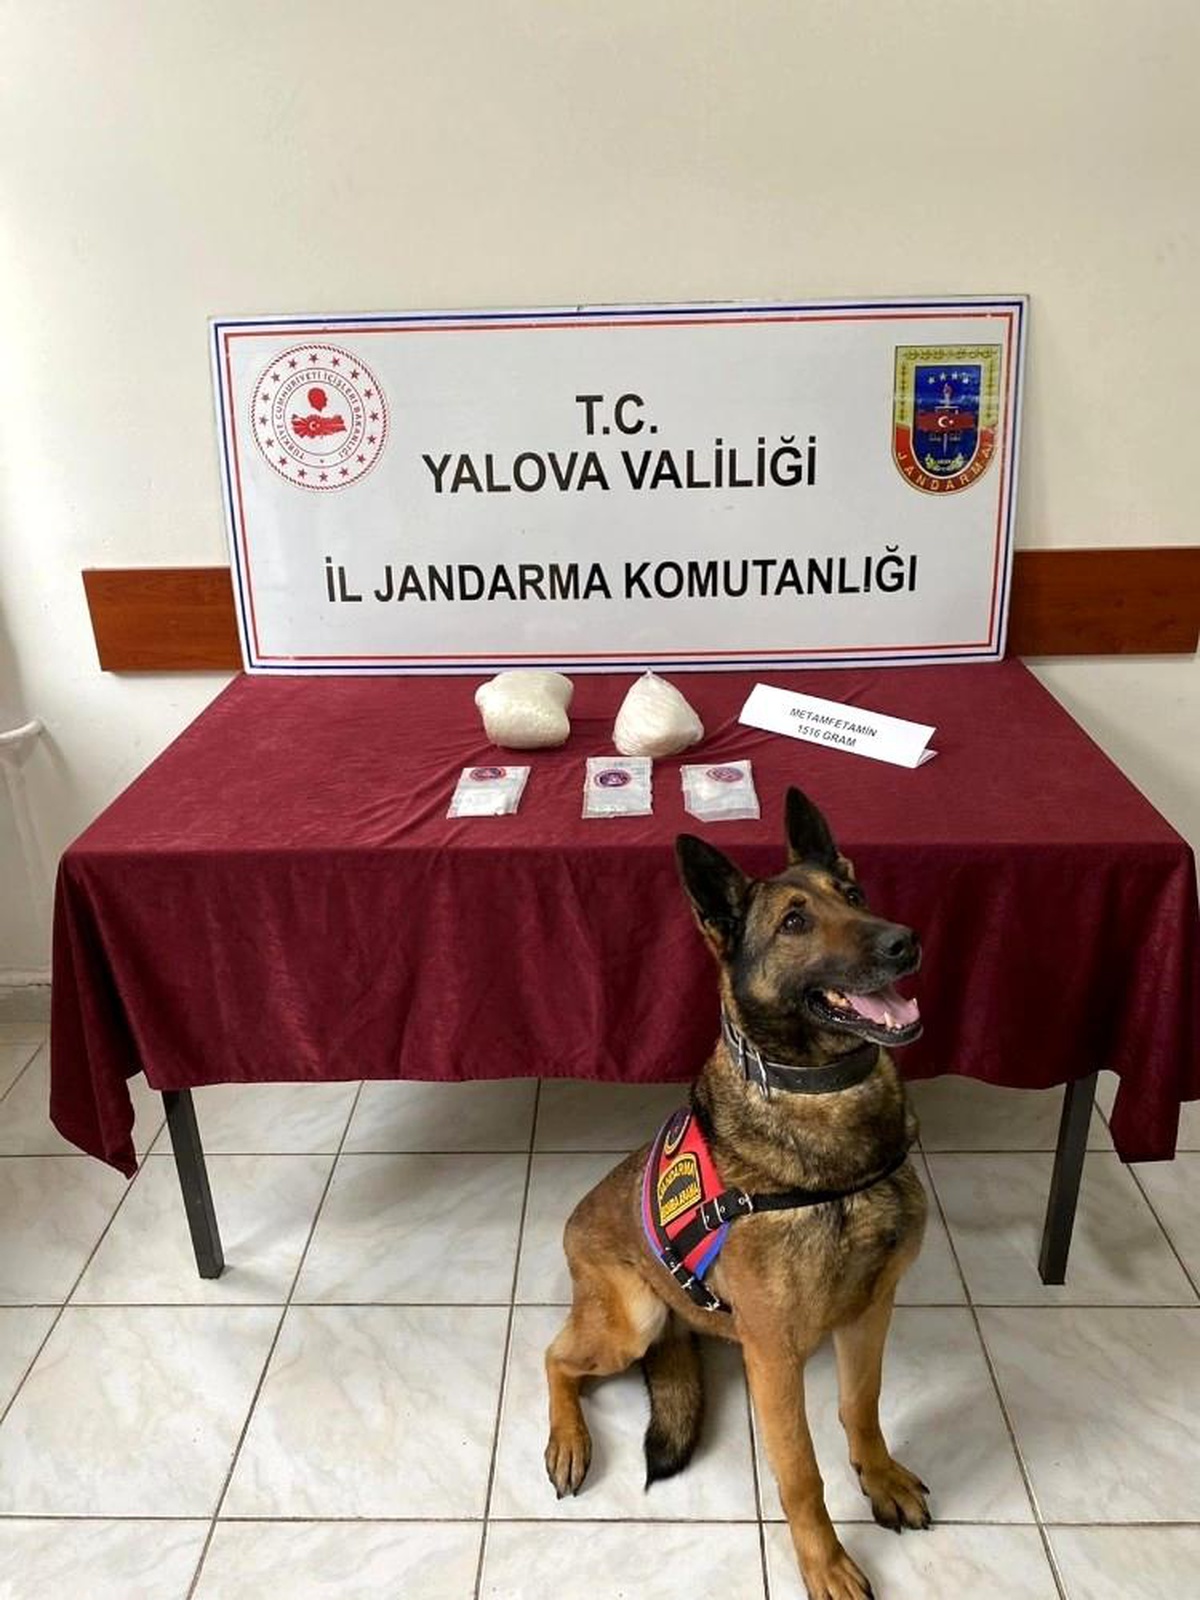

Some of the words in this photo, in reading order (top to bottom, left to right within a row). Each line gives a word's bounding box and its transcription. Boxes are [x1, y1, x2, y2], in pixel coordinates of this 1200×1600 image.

[575, 393, 658, 435] T.C.
[422, 451, 610, 493] YALOVA
[620, 434, 816, 490] VALİLİĞİ
[897, 443, 993, 491] JANDARMA
[325, 556, 363, 602] İL
[374, 562, 612, 602] JANDARMA
[624, 544, 917, 599] KOMUTANLIĞI
[789, 707, 878, 738] METAMFETAMİN
[797, 723, 820, 738] 1516
[822, 731, 857, 748] GRAM
